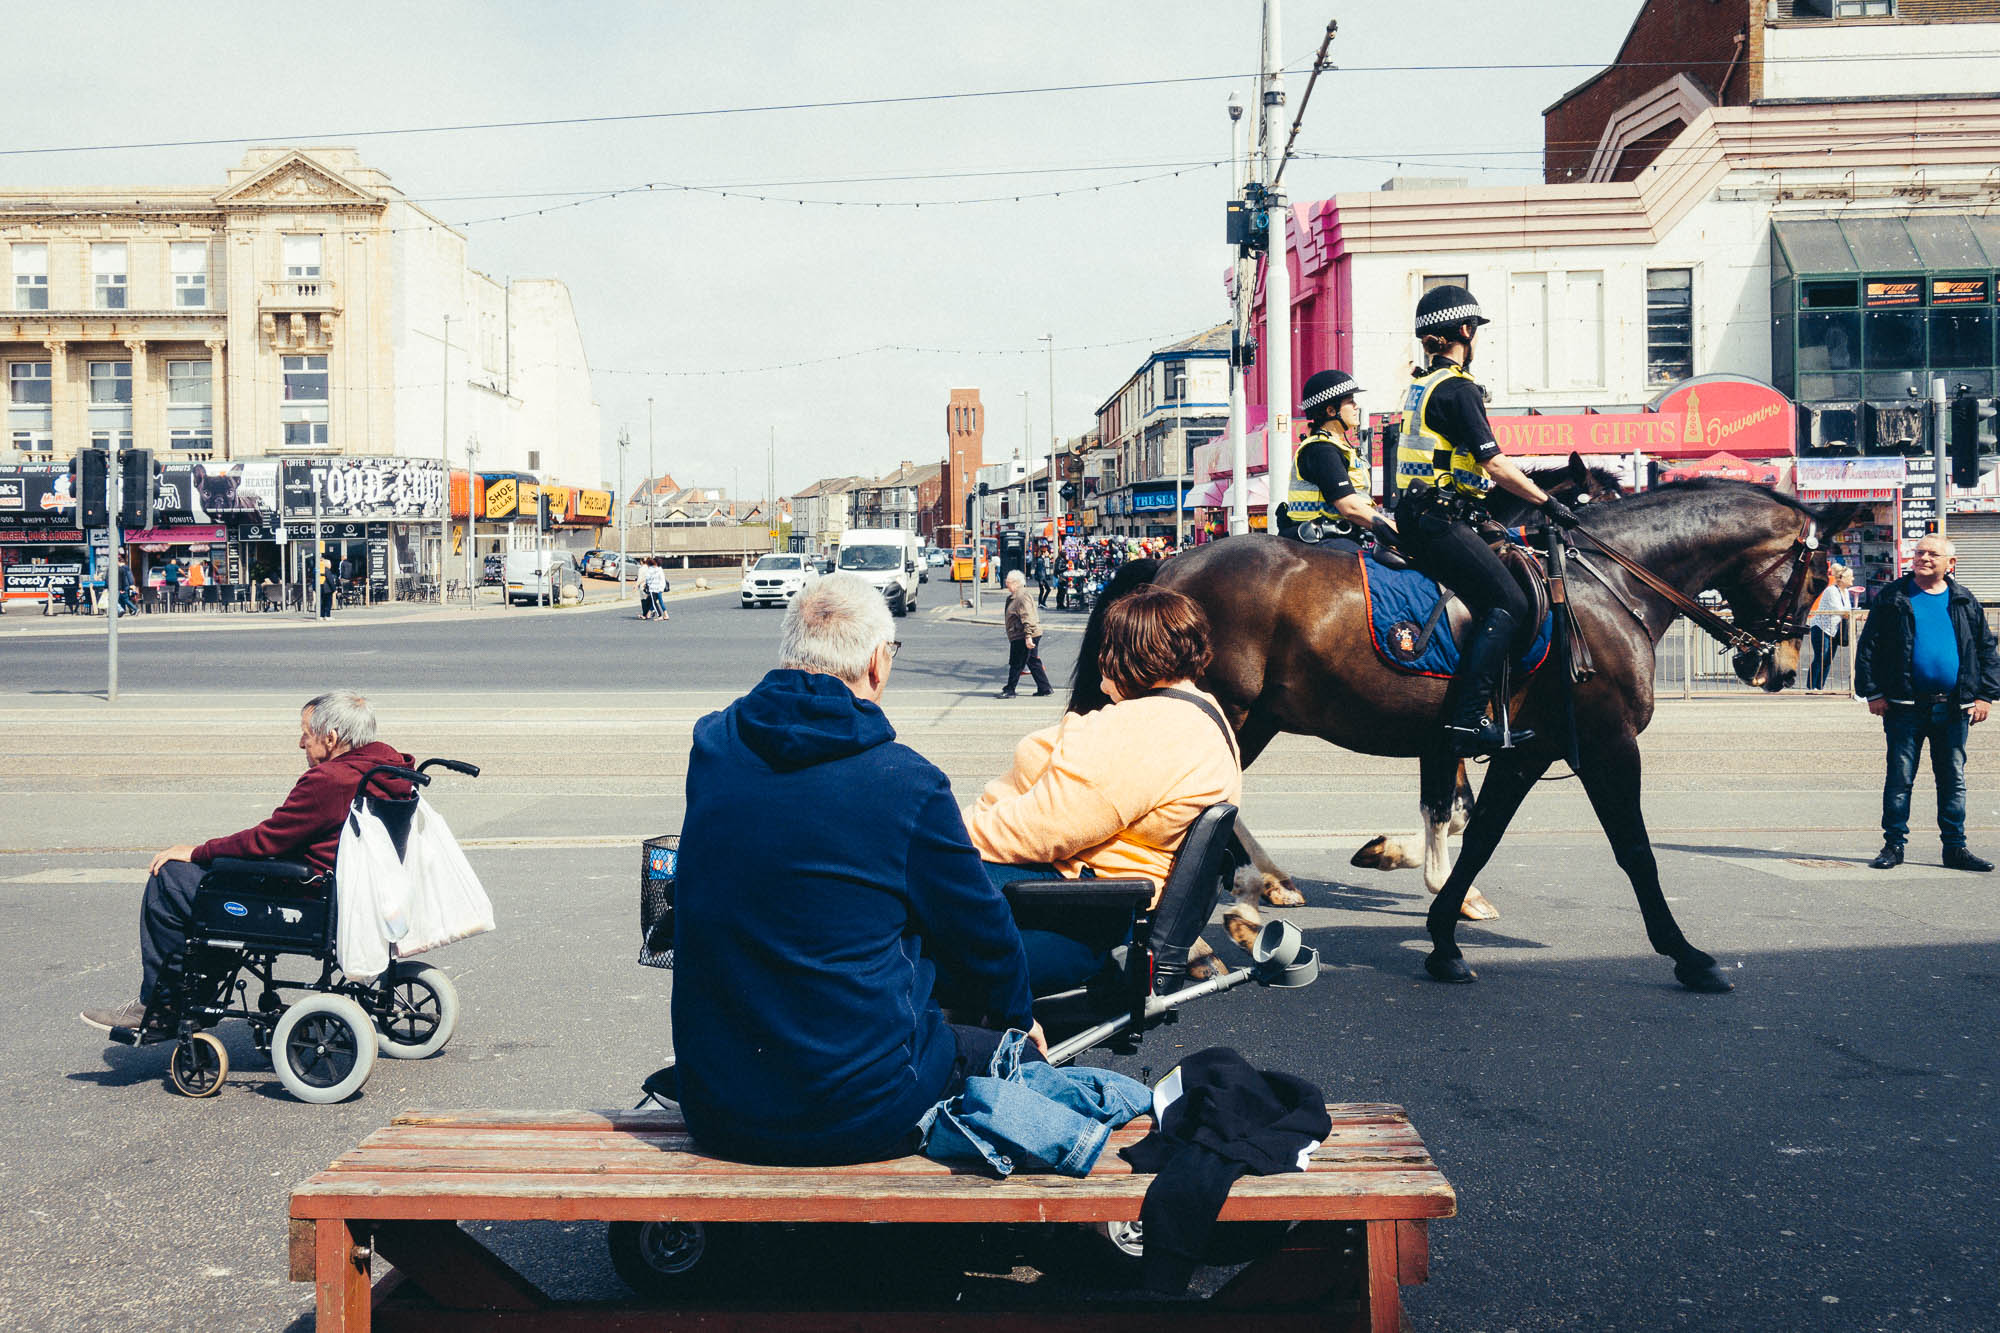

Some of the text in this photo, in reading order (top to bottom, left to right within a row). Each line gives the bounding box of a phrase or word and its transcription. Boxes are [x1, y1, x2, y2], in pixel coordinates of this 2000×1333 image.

[1707, 403, 1782, 447] Souvenirs
[1490, 420, 1676, 448] OWER GIFTS
[488, 483, 514, 505] SHOE
[1802, 487, 1893, 500] The Perfume Box
[489, 495, 515, 516] CELLAR
[1135, 495, 1175, 506] THE SEA
[1908, 501, 1930, 509] ALL
[1902, 510, 1936, 519] STOCK
[1904, 520, 1926, 529] MUS
[8, 575, 76, 588] Greedy Zak's
